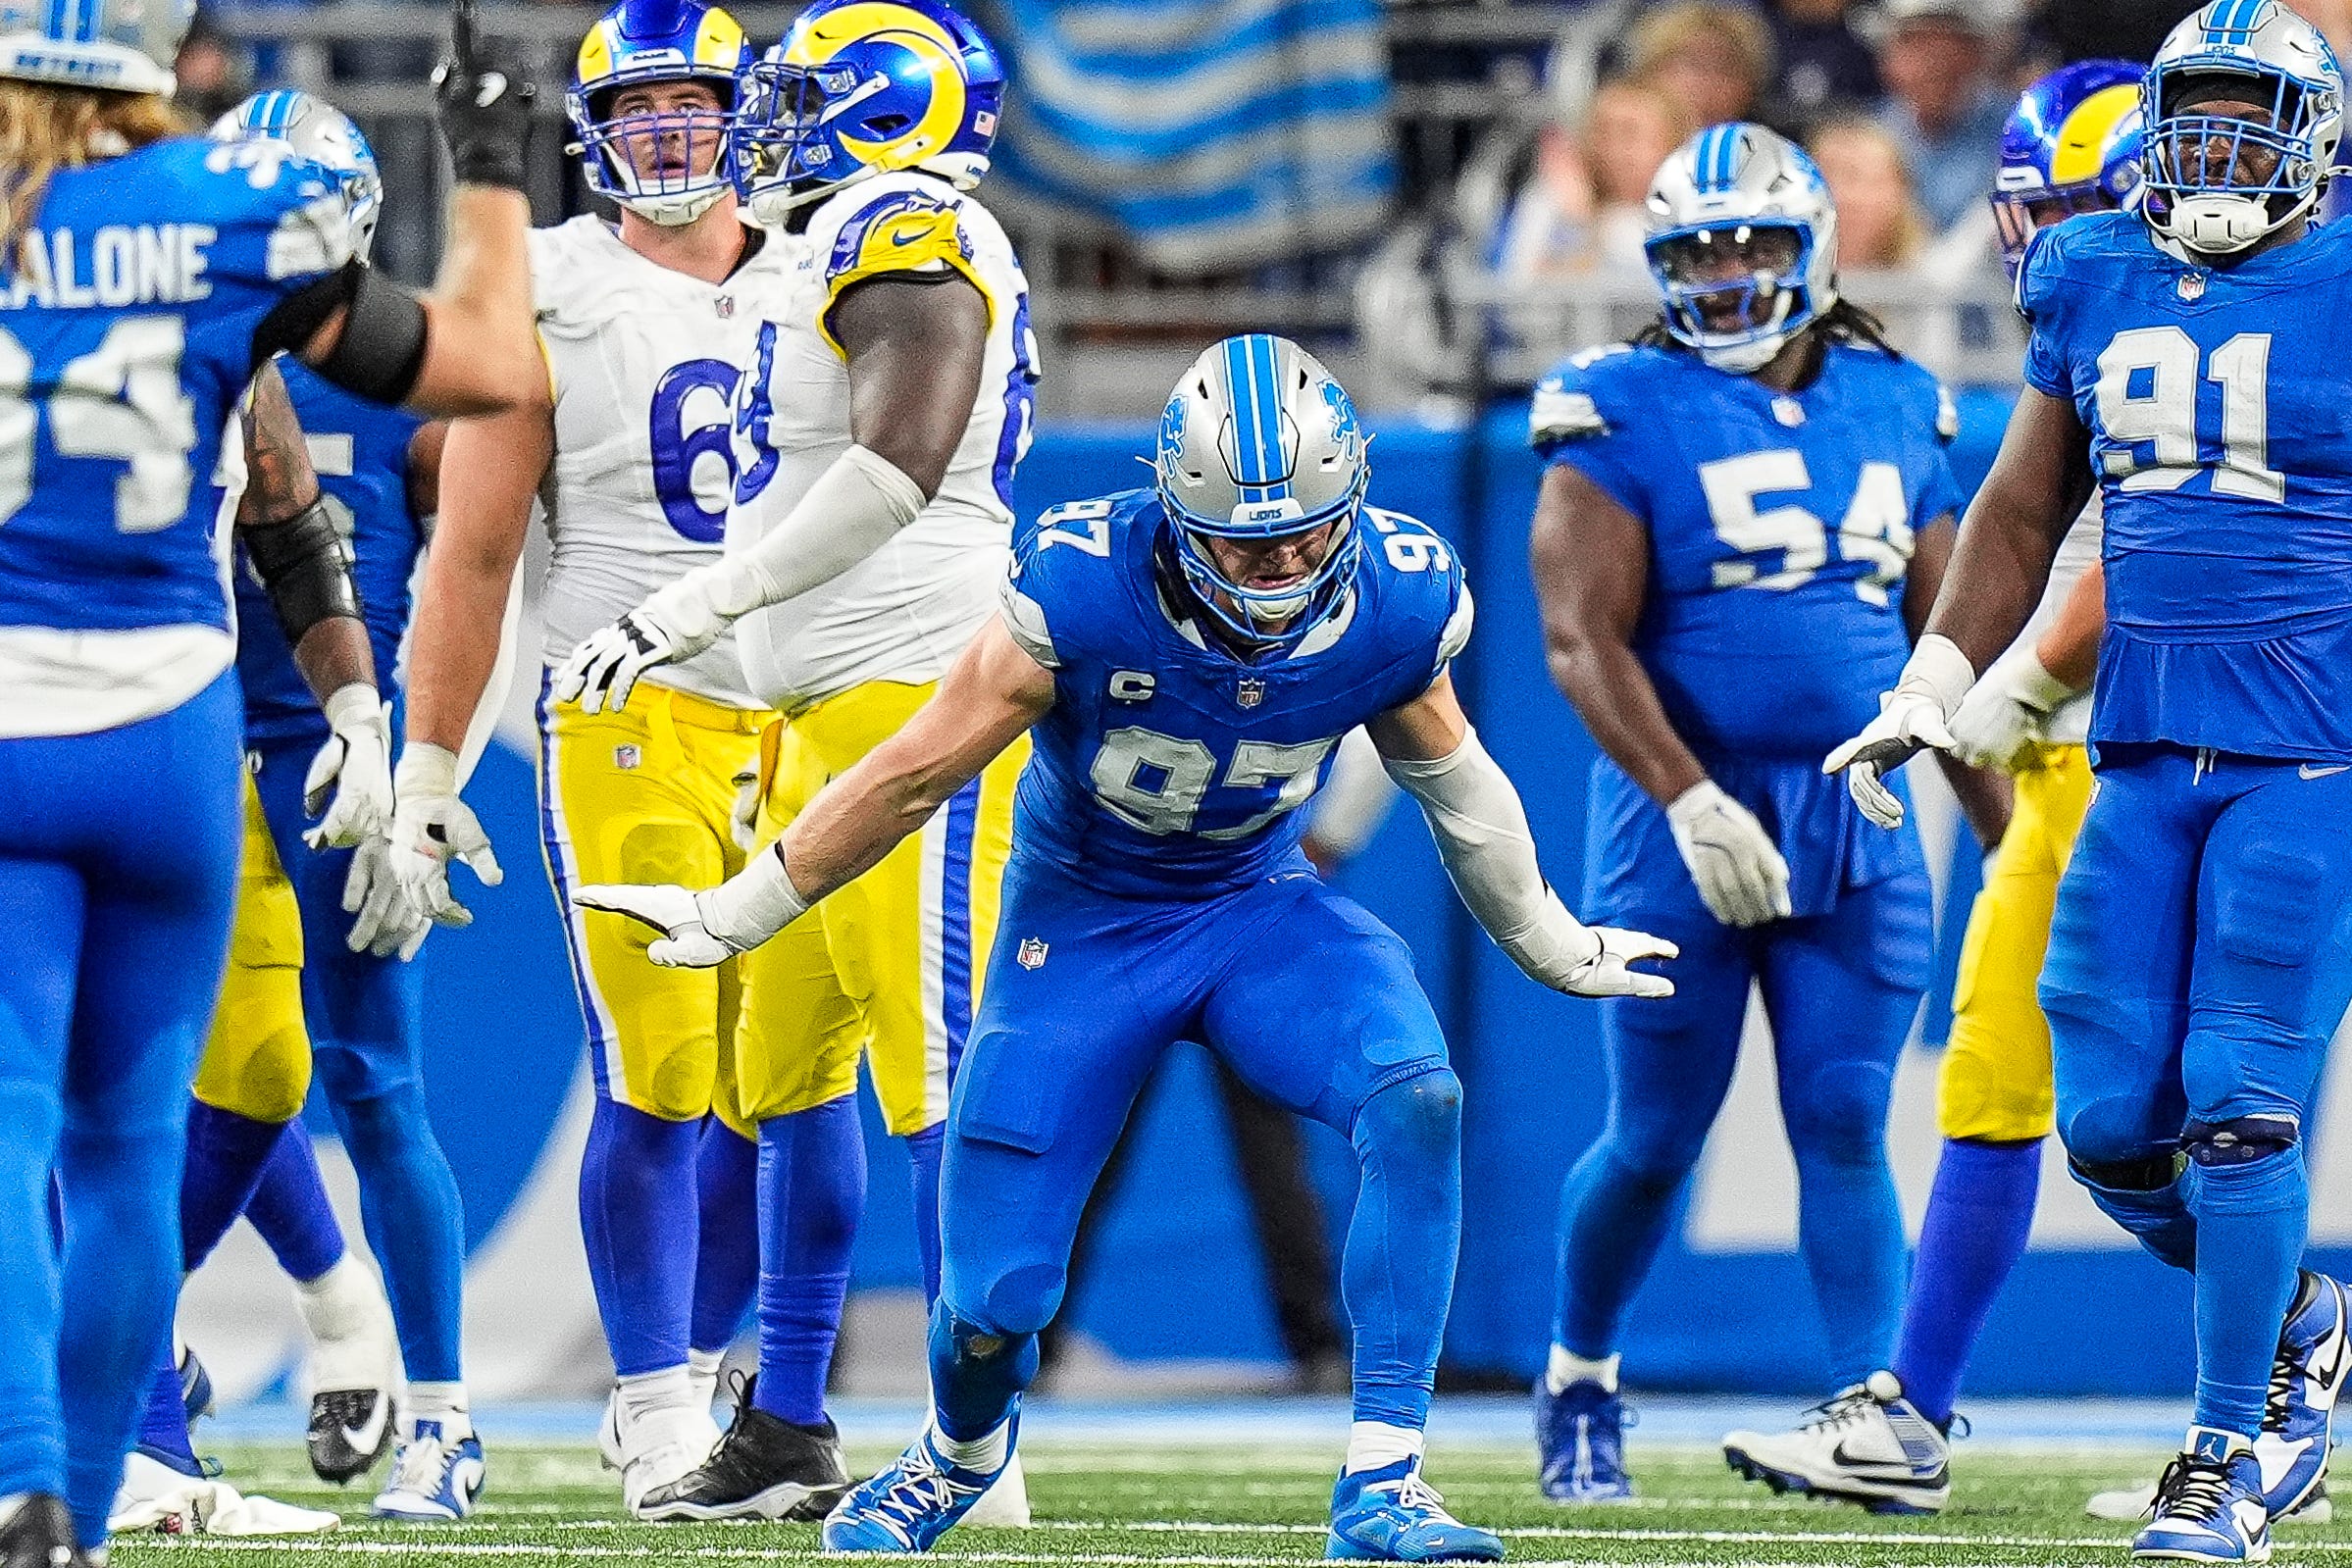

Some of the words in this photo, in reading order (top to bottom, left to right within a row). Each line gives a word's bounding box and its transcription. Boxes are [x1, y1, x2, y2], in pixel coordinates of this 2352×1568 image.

[0, 222, 218, 310] ALONE
[0, 312, 198, 534] 4
[2096, 325, 2286, 504] 91
[1249, 507, 1283, 521] LIONS
[1699, 446, 1917, 609] 54
[1109, 670, 1155, 701] C
[1089, 725, 1340, 841] 97
